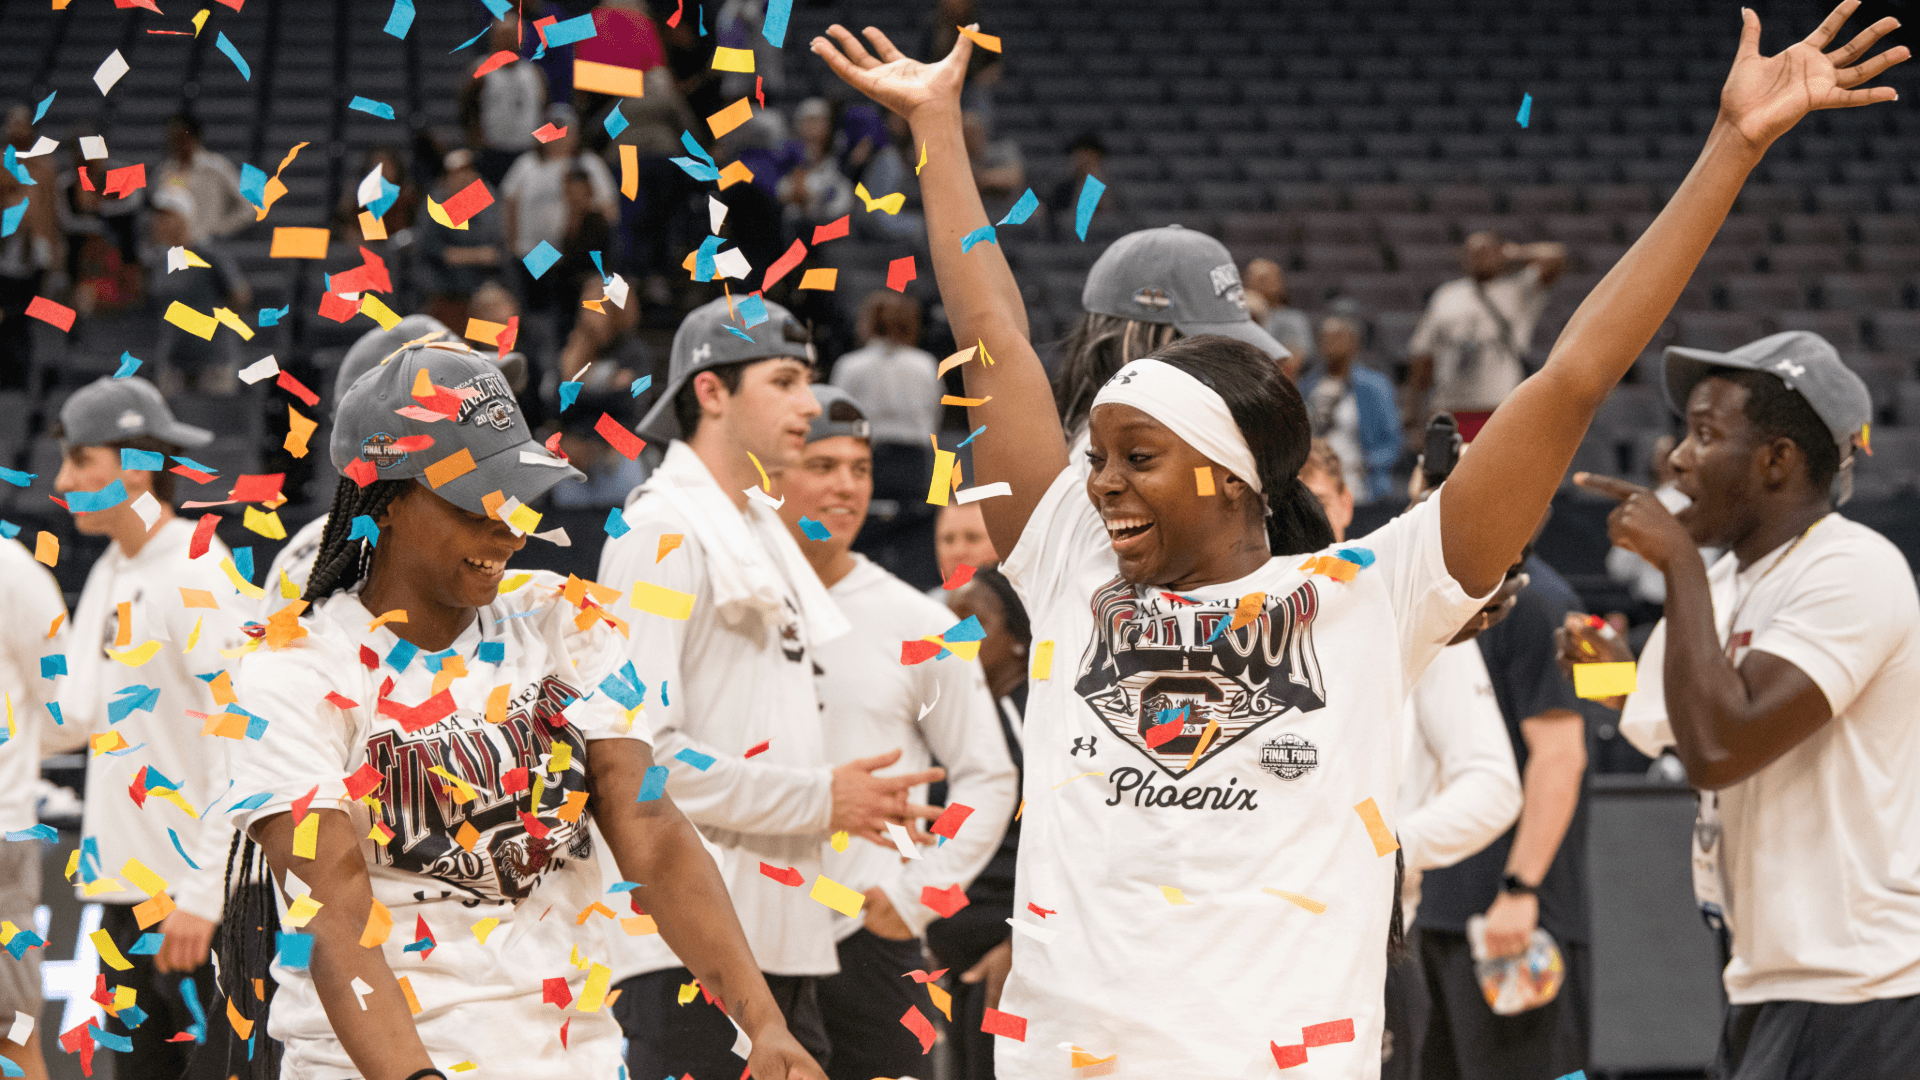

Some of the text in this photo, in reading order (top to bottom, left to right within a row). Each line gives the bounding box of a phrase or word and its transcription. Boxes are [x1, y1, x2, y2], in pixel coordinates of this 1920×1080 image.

[474, 414, 488, 426] 20
[363, 445, 382, 454] FINAL
[1228, 688, 1272, 719] 26
[1263, 749, 1316, 763] FINAL FOUR
[366, 728, 514, 868] FINAL
[1105, 766, 1258, 811] Phoenix
[428, 850, 484, 881] 20
